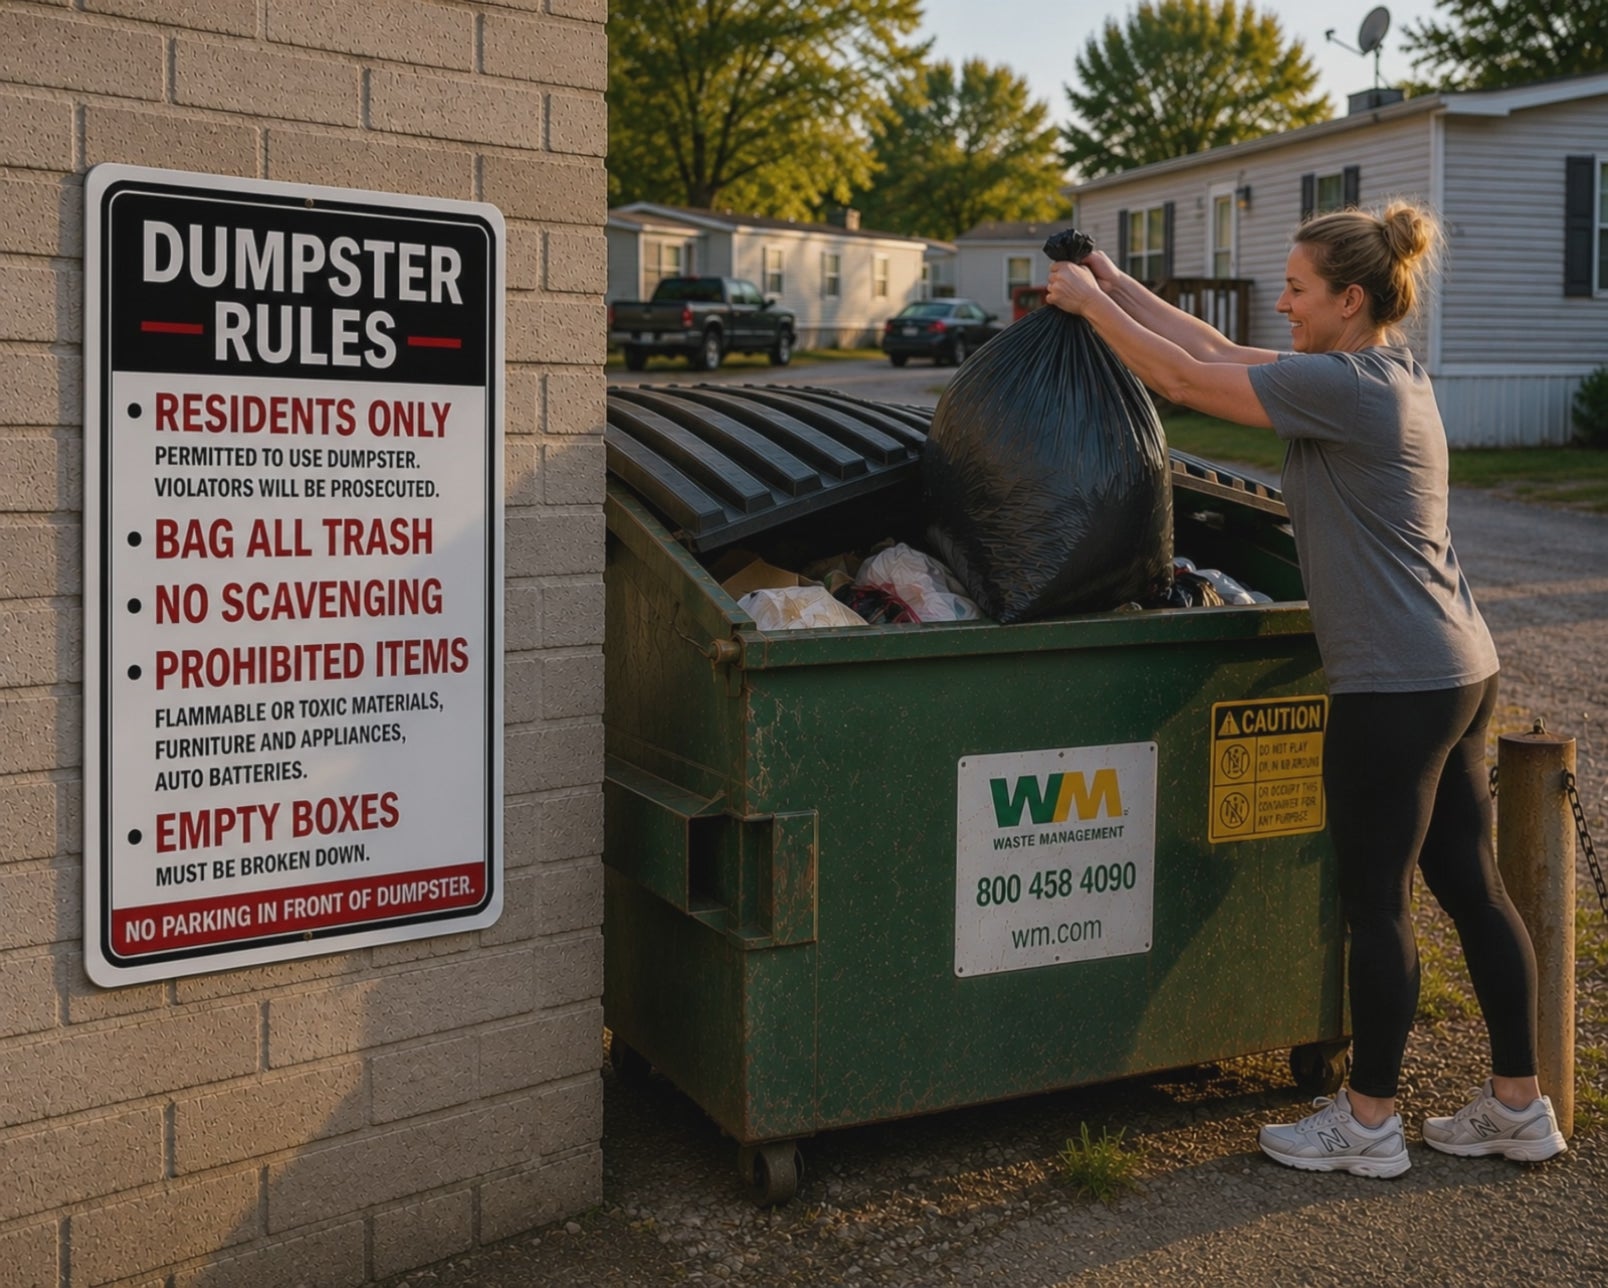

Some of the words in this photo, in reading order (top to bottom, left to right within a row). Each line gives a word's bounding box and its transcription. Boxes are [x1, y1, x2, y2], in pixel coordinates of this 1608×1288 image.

[142, 220, 463, 304] DUMPSTER
[215, 301, 397, 369] RULES
[155, 393, 356, 436] RESIDENTS
[368, 400, 452, 438] ONLY
[155, 447, 257, 467] PERMITTED
[262, 449, 284, 467] TO
[289, 449, 322, 467] USE
[328, 450, 420, 469] DUMPSTER.
[155, 478, 254, 498] VIOLATORS
[259, 479, 299, 497] WILL
[304, 480, 325, 497] BE
[331, 480, 439, 498] PROSECUTED.
[155, 519, 234, 559] BAG
[247, 519, 312, 557] ALL
[323, 518, 433, 555] TRASH
[155, 583, 209, 625] NO
[222, 578, 443, 622] SCAVENGING
[155, 643, 364, 690] PROHIBITED
[376, 637, 469, 677] ITEMS
[155, 703, 266, 728] FLAMMABLE
[271, 702, 295, 720] OR
[299, 698, 347, 719] TOXIC
[352, 691, 443, 715] MATERIALS,
[1242, 705, 1320, 733] CAUTION
[155, 735, 256, 760] FURNITURE
[260, 731, 296, 751] AND
[301, 724, 406, 748] APPLIANCES,
[1259, 745, 1270, 755] DO
[1273, 743, 1286, 753] NOT
[1290, 741, 1308, 751] PLAY
[155, 769, 203, 791] AUTO
[209, 761, 307, 786] BATTERIES.
[990, 768, 1123, 828] WM
[155, 803, 280, 853] EMPTY
[292, 791, 400, 838] BOXES
[993, 835, 1035, 850] WASTE
[1040, 826, 1124, 845] MANAGEMENT
[156, 863, 207, 887] MUST
[213, 860, 235, 879] BE
[241, 851, 310, 877] BROKEN
[315, 844, 370, 868] DOWN.
[977, 874, 1021, 907] 800
[1029, 869, 1072, 899] 458
[1080, 861, 1136, 894] 4090
[125, 919, 155, 943] NO
[162, 905, 251, 938] PARKING
[257, 901, 277, 923] IN
[284, 892, 343, 920] FRONT
[348, 889, 372, 911] OF
[377, 875, 475, 907] DUMPSTER.
[1012, 919, 1102, 949] wm.com
[1318, 1128, 1350, 1153] N
[1471, 1114, 1500, 1137] N
